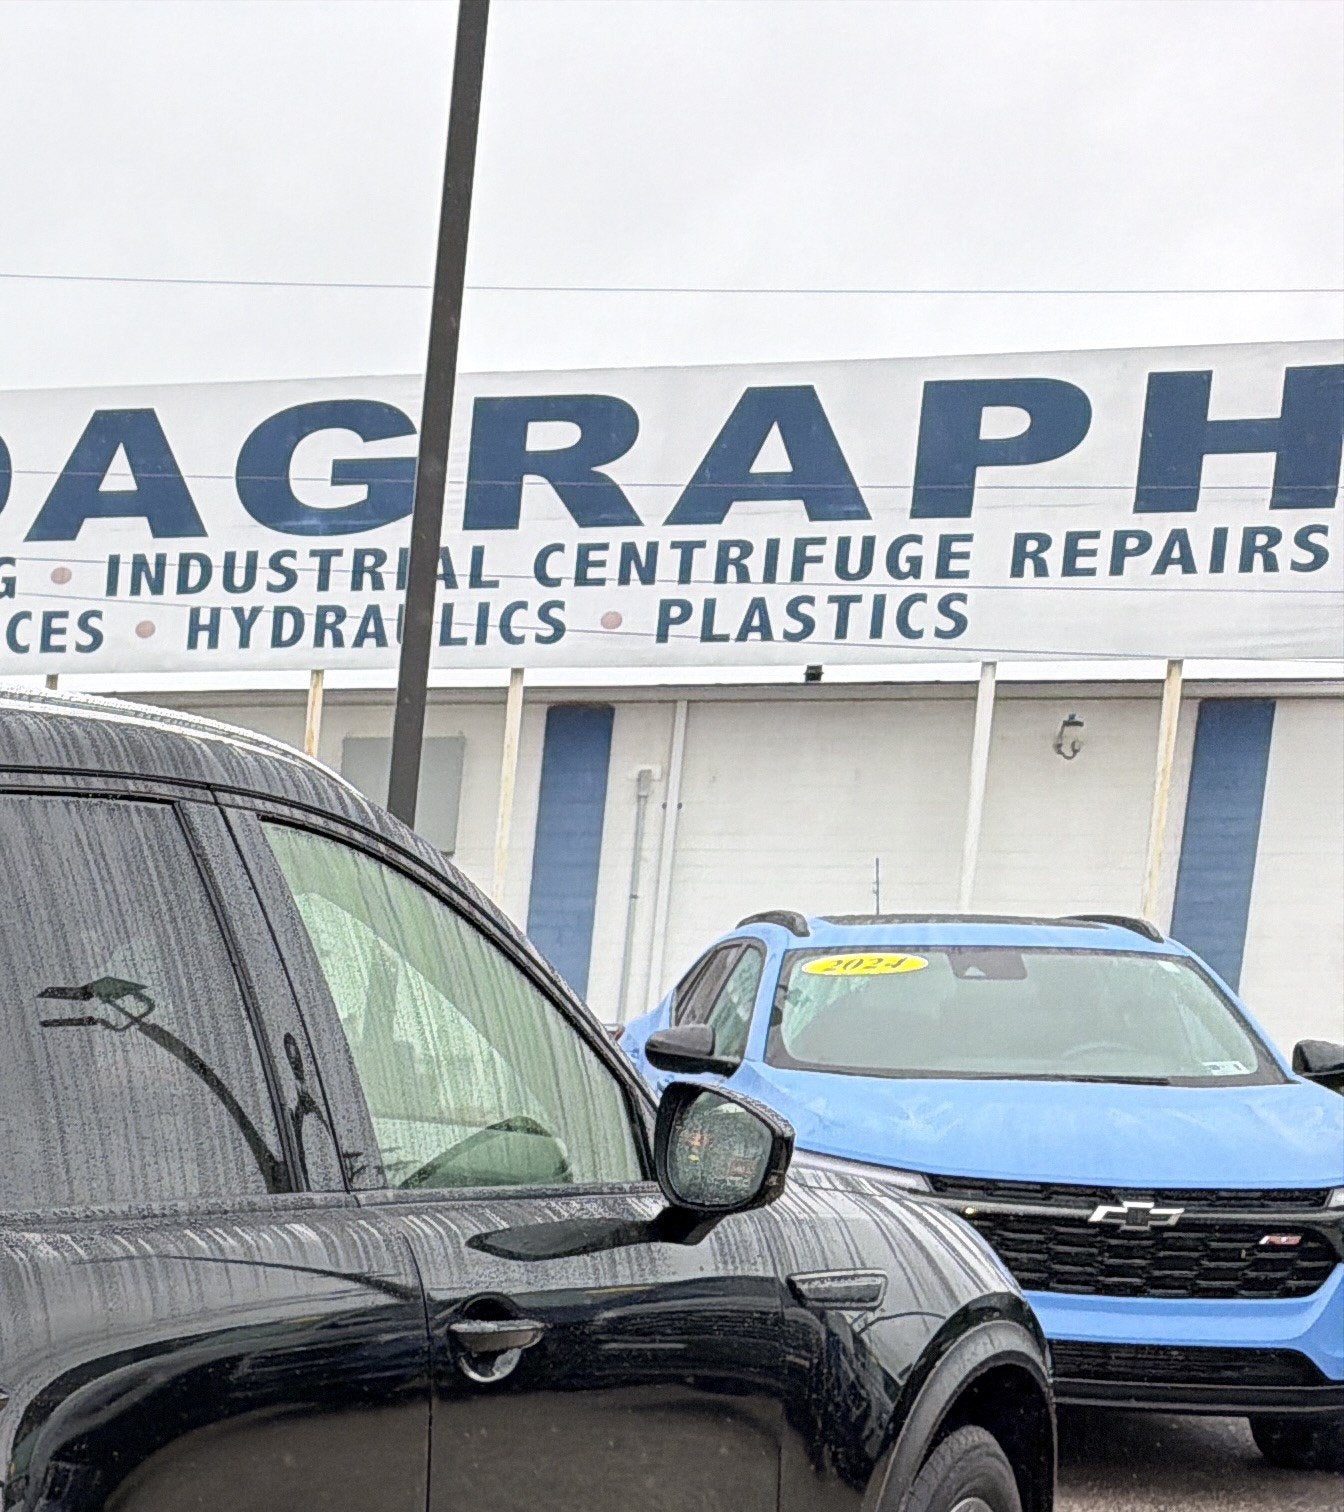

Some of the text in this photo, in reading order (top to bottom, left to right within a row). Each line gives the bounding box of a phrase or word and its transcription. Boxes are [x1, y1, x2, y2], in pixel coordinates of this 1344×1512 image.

[105, 544, 501, 598] INDUSTRIAL
[532, 532, 976, 588] CENTRIFUGE
[1010, 523, 1331, 580] REPAIRS
[186, 599, 568, 651] HYDRALICS
[654, 591, 970, 645] PLASTICS
